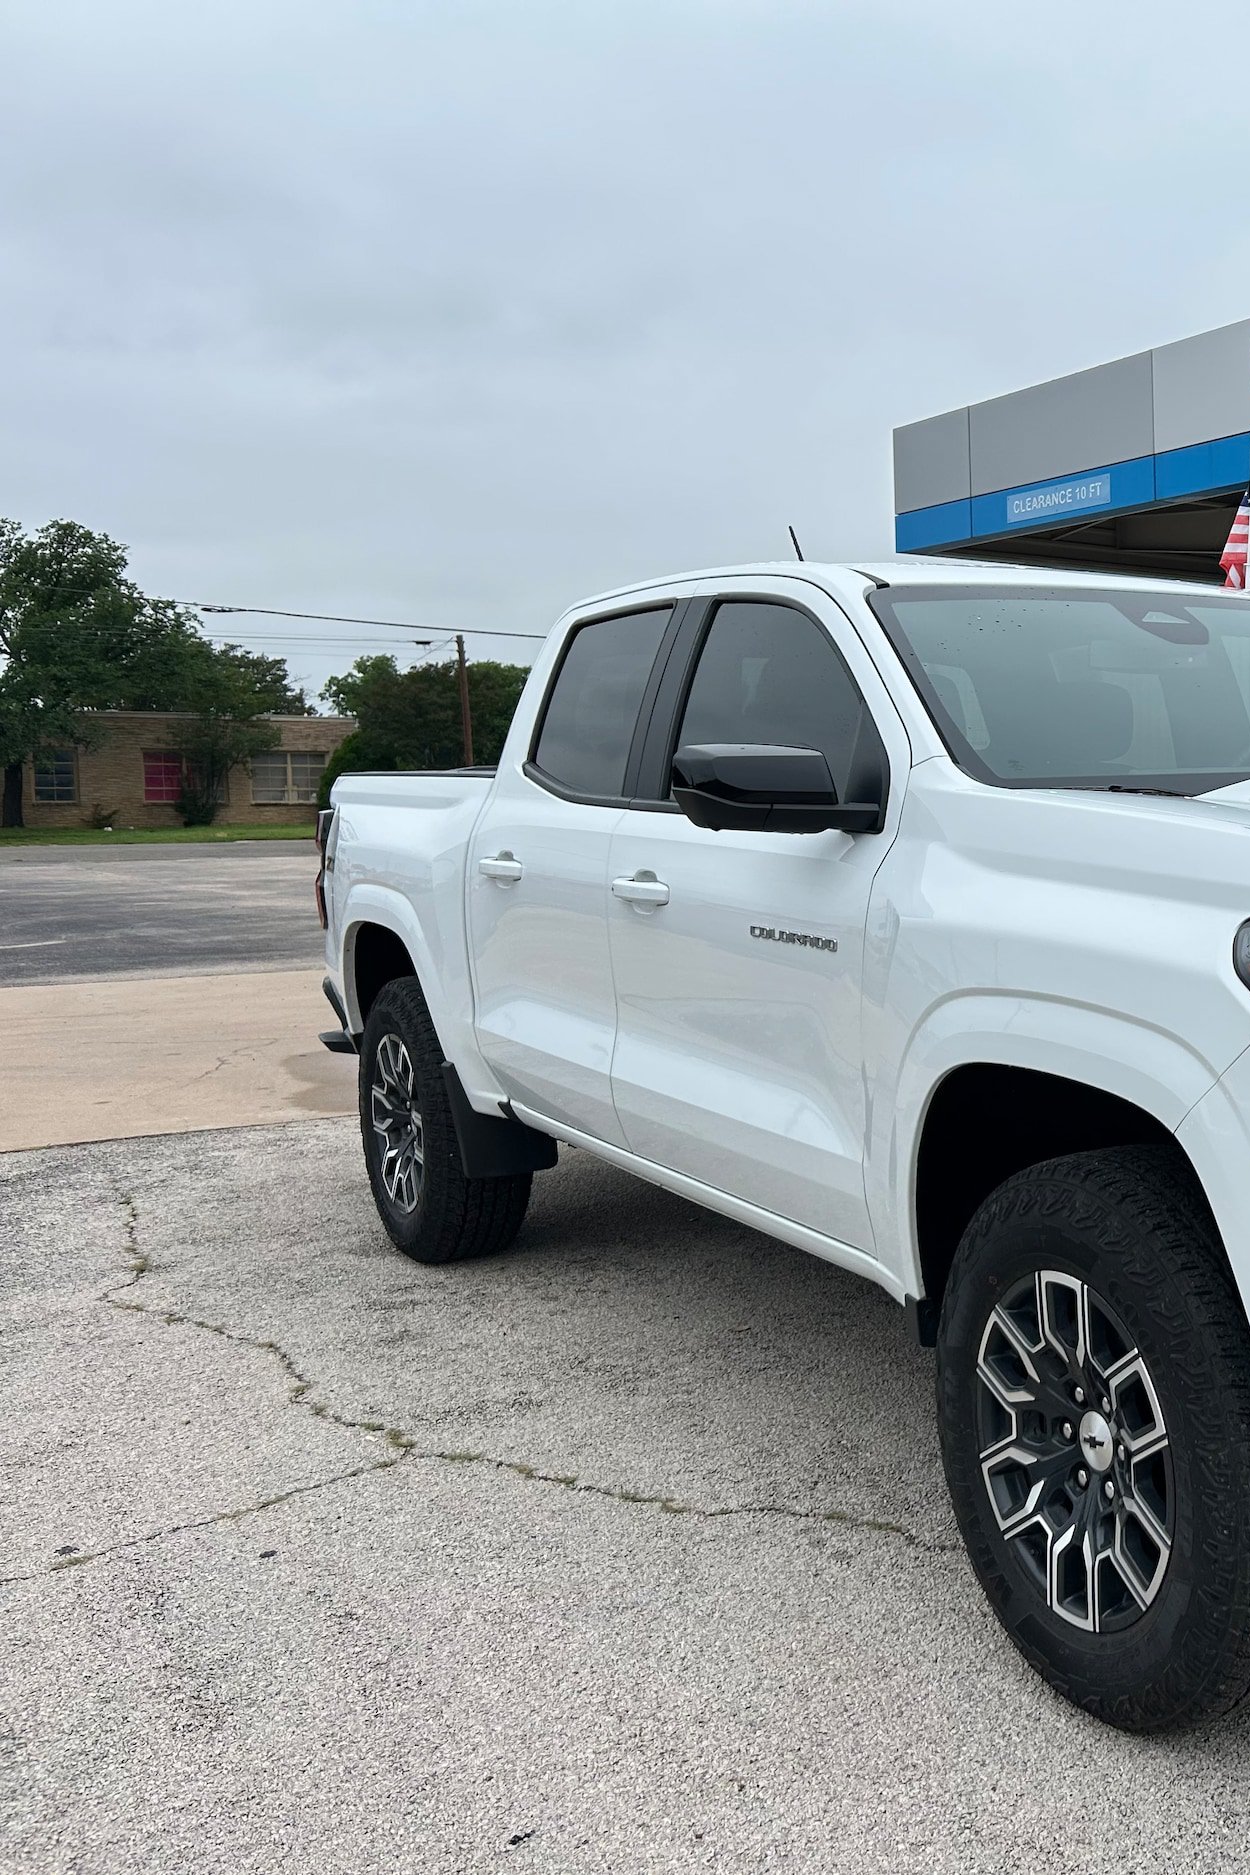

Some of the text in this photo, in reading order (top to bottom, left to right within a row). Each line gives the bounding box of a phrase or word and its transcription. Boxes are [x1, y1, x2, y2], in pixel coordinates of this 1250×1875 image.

[1013, 481, 1102, 514] CLEARANCE 10 FT
[749, 925, 838, 952] COLORADO
